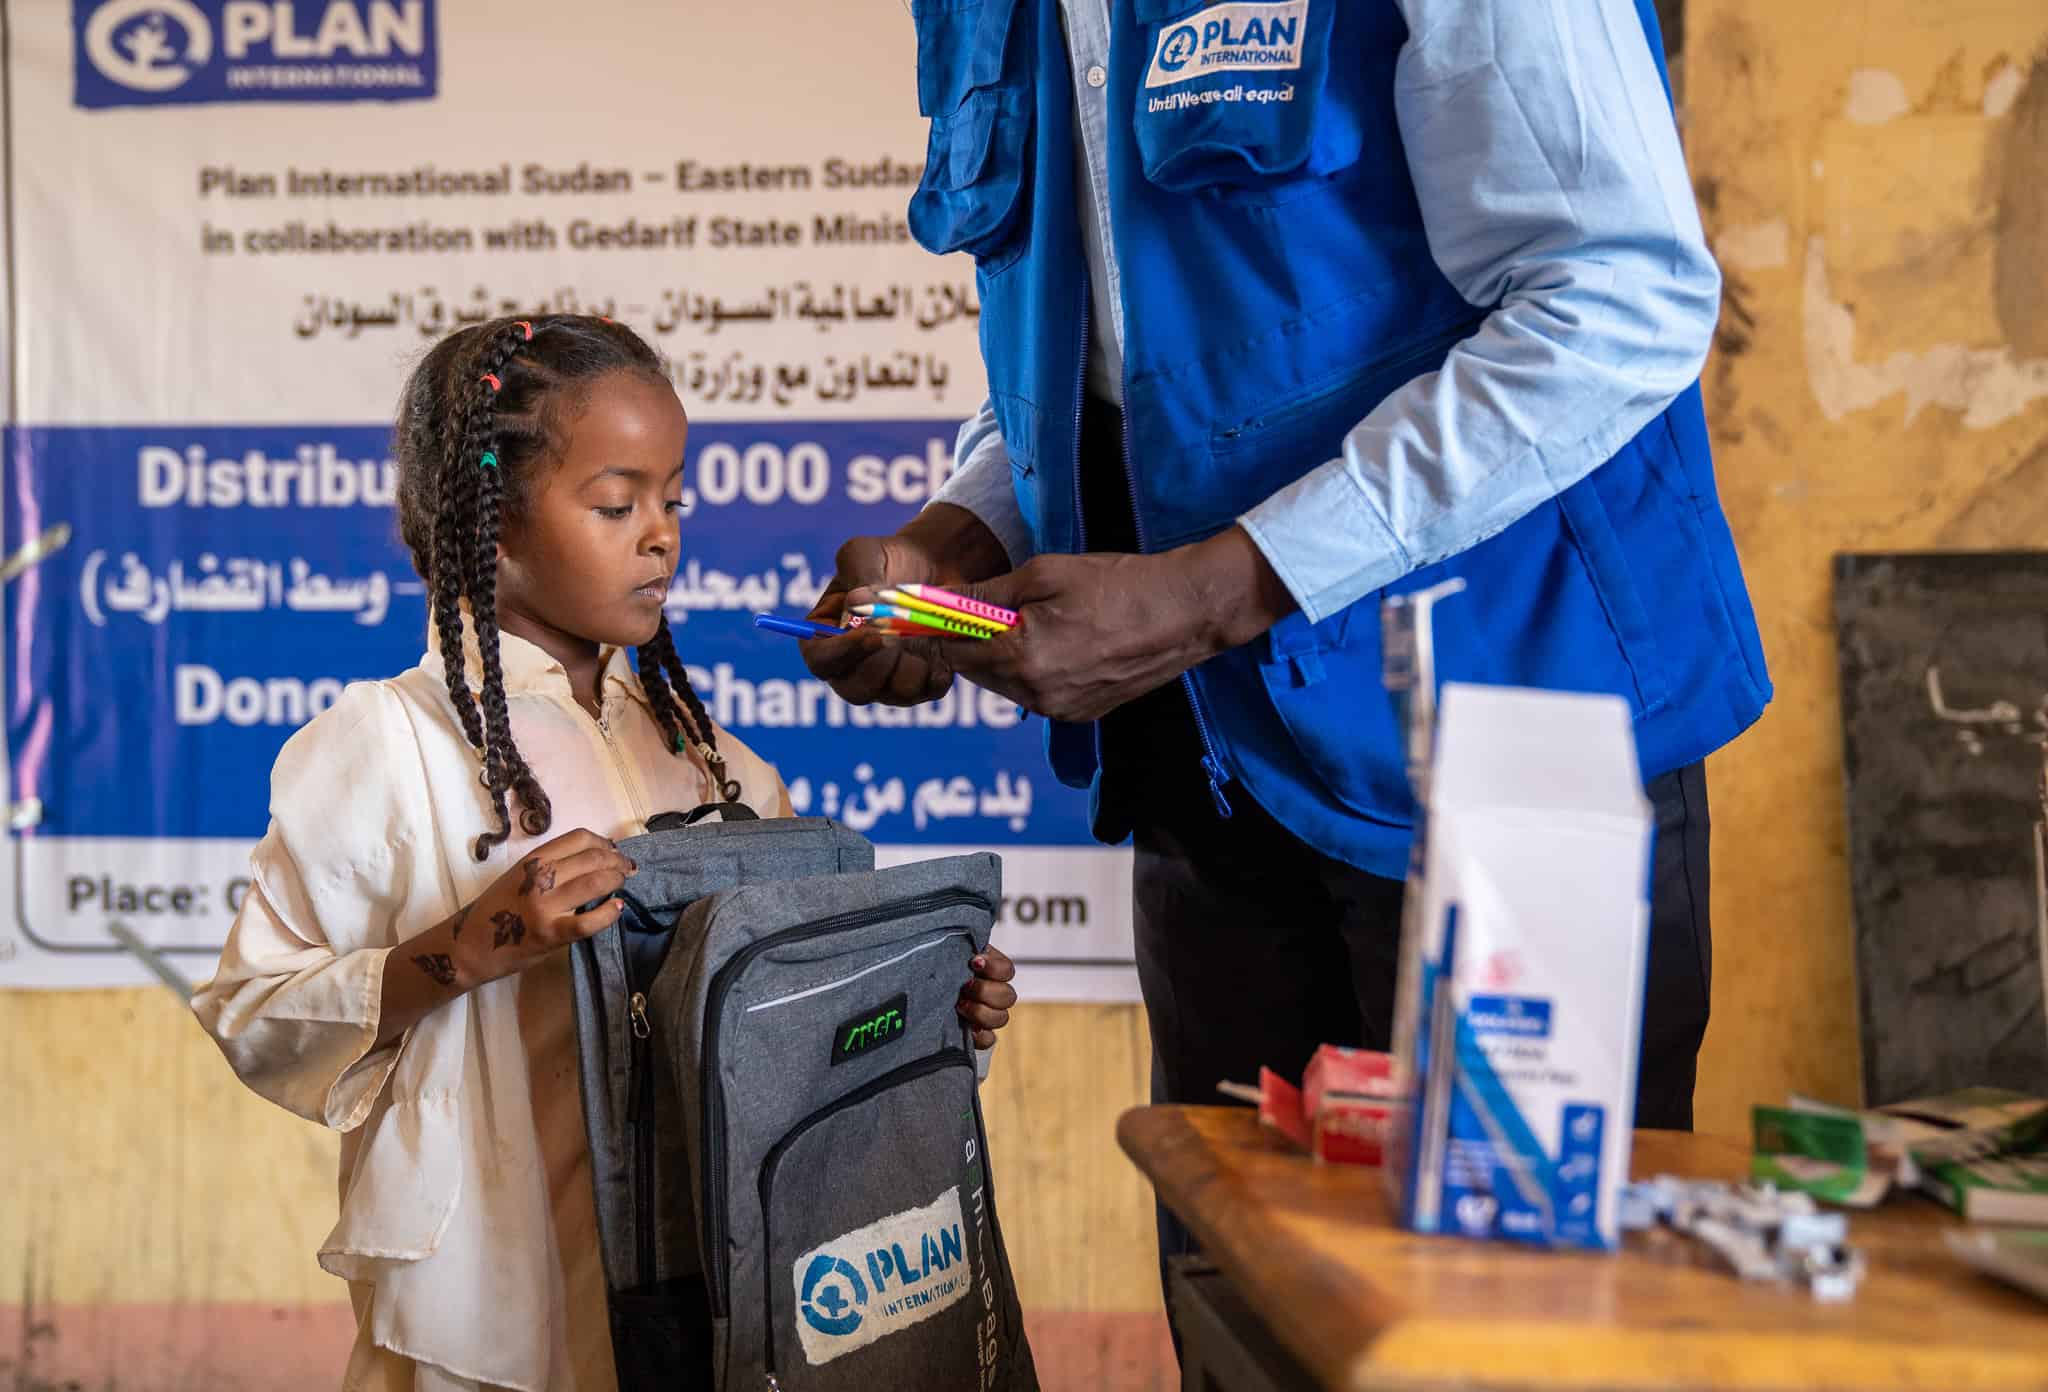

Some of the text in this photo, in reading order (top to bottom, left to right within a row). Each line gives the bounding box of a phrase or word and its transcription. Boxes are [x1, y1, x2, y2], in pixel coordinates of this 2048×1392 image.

[223, 0, 424, 58] PLAN
[1202, 16, 1296, 50] PLAN
[226, 65, 424, 88] INTERNATIONAL
[1200, 49, 1293, 66] INTERNATIONAL
[1224, 84, 1243, 102] all
[1246, 85, 1294, 105] equal
[200, 166, 277, 197] Plan
[288, 163, 509, 197] International
[522, 161, 632, 194] Sudan
[676, 161, 812, 192] Eastern
[203, 212, 909, 252] in collaboration with Gedarif State Minis
[139, 438, 955, 517] Distribu ,000 sch
[175, 664, 352, 726] Dono
[67, 876, 208, 916] Place:
[865, 1223, 962, 1294] PLAN
